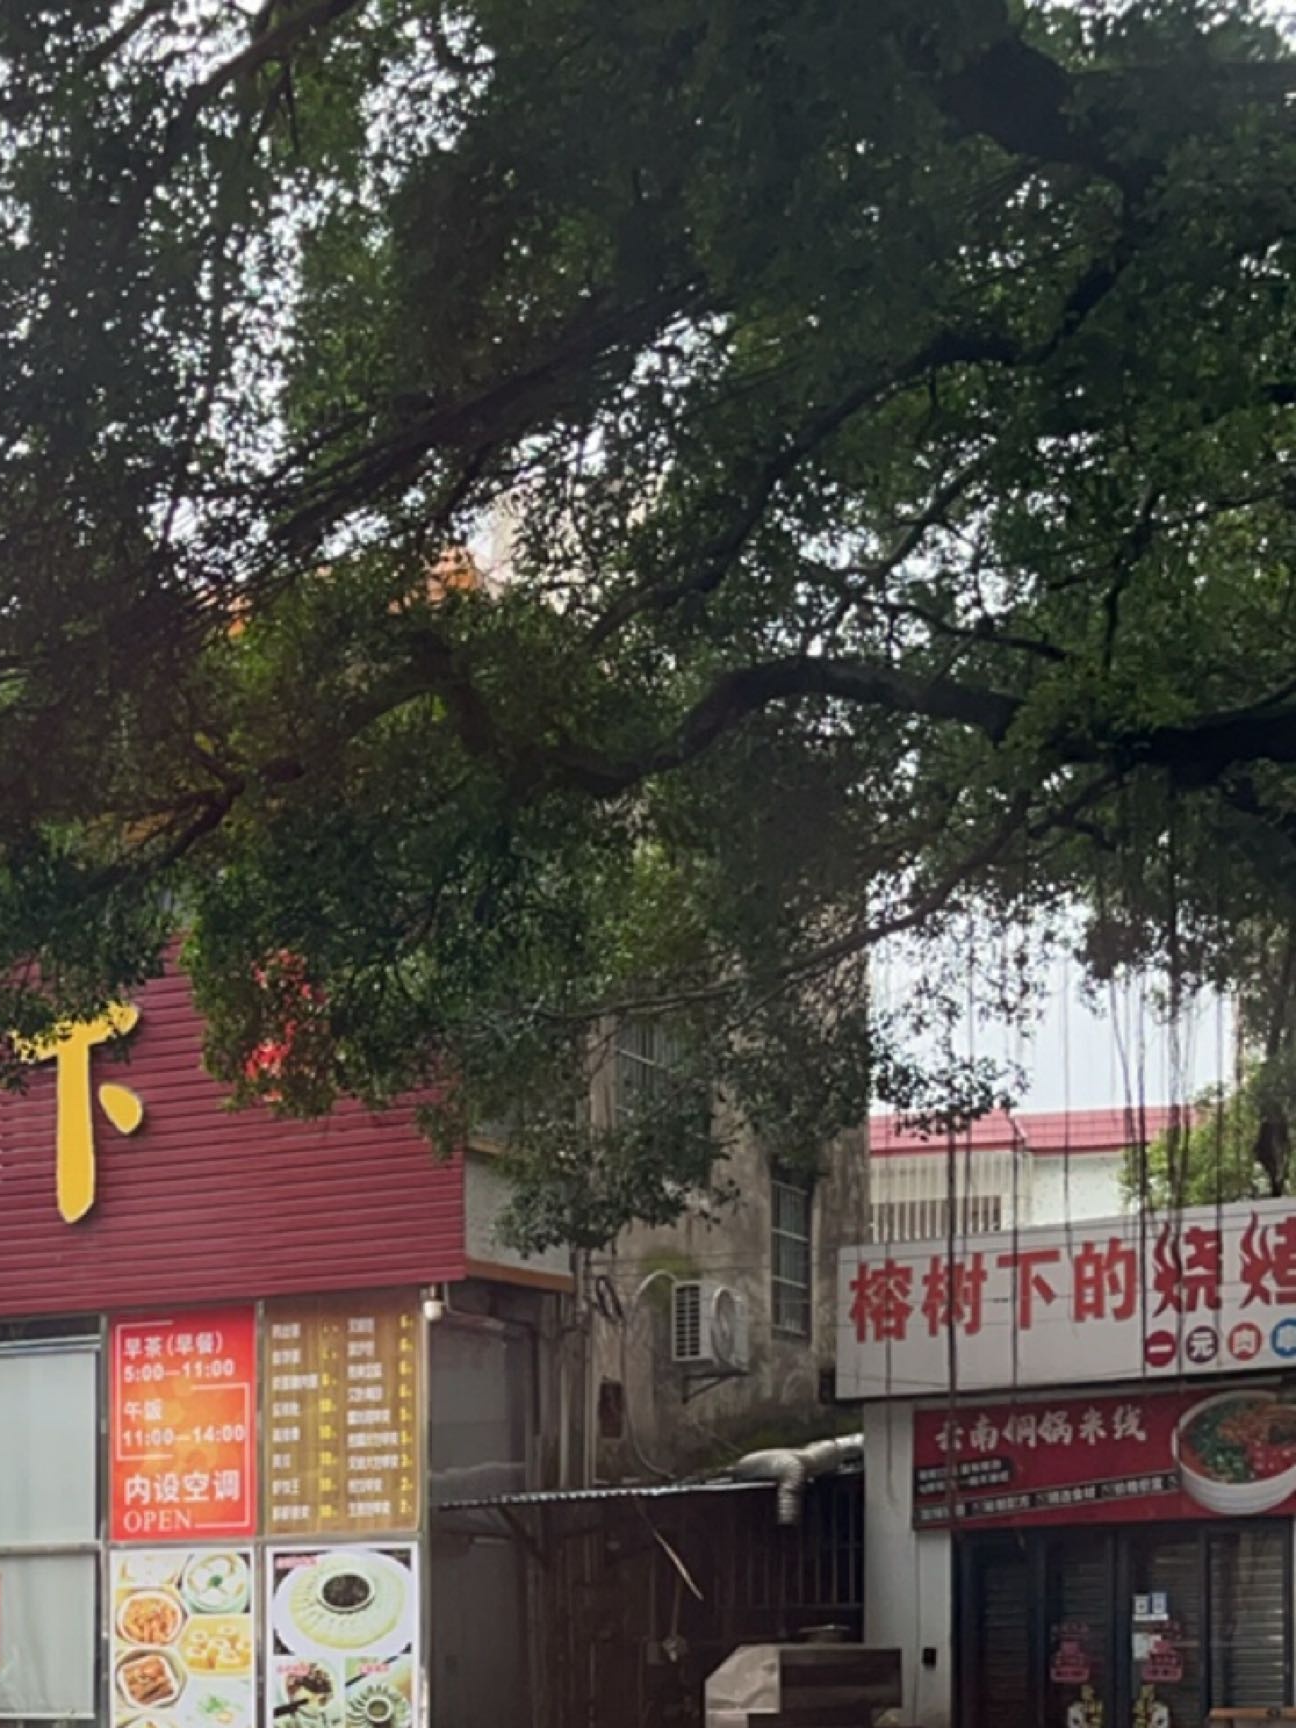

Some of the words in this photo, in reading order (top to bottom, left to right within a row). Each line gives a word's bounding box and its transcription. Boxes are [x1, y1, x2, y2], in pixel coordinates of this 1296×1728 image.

[123, 1468, 242, 1506] 内设空调
[122, 1508, 193, 1533] OPEN
